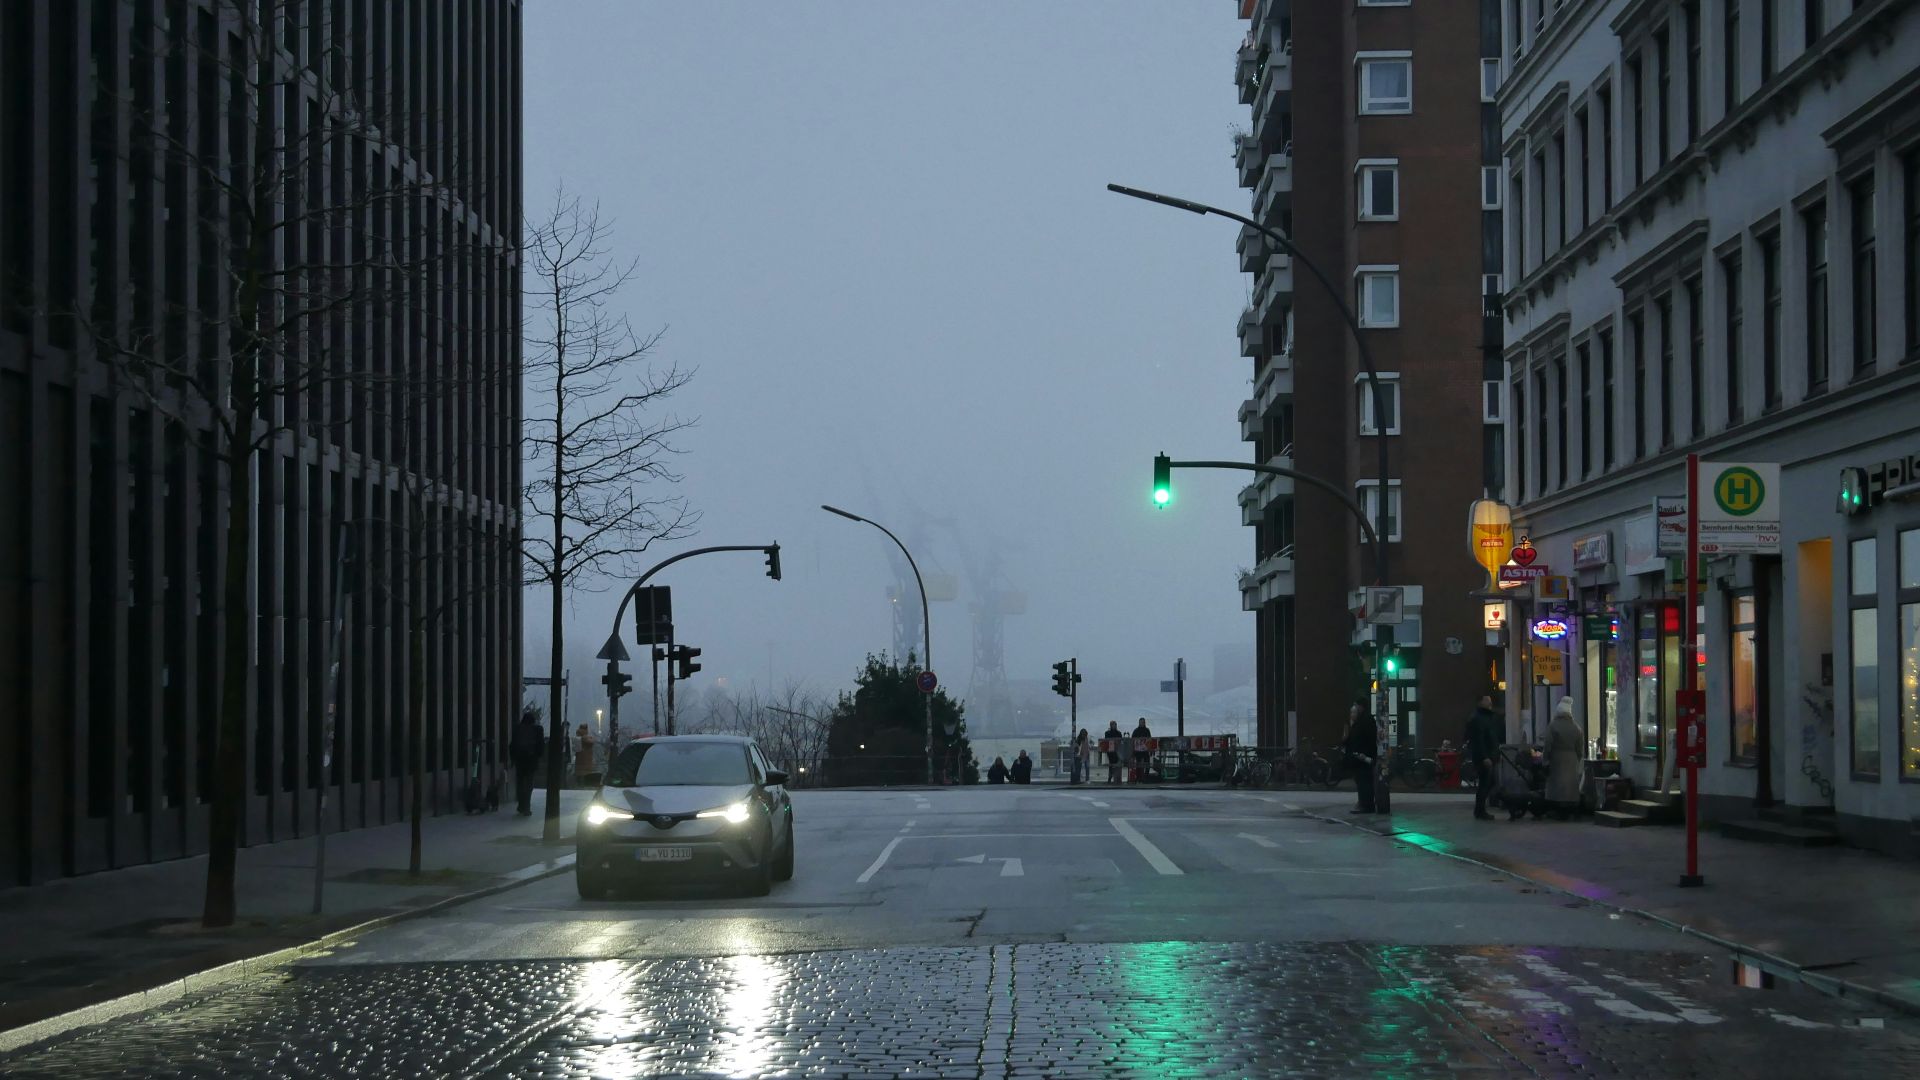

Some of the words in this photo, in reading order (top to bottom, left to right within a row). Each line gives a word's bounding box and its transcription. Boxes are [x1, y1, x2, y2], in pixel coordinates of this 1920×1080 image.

[1727, 478, 1751, 505] H
[1503, 568, 1545, 578] ASTRA
[1533, 655, 1561, 663] Coffee
